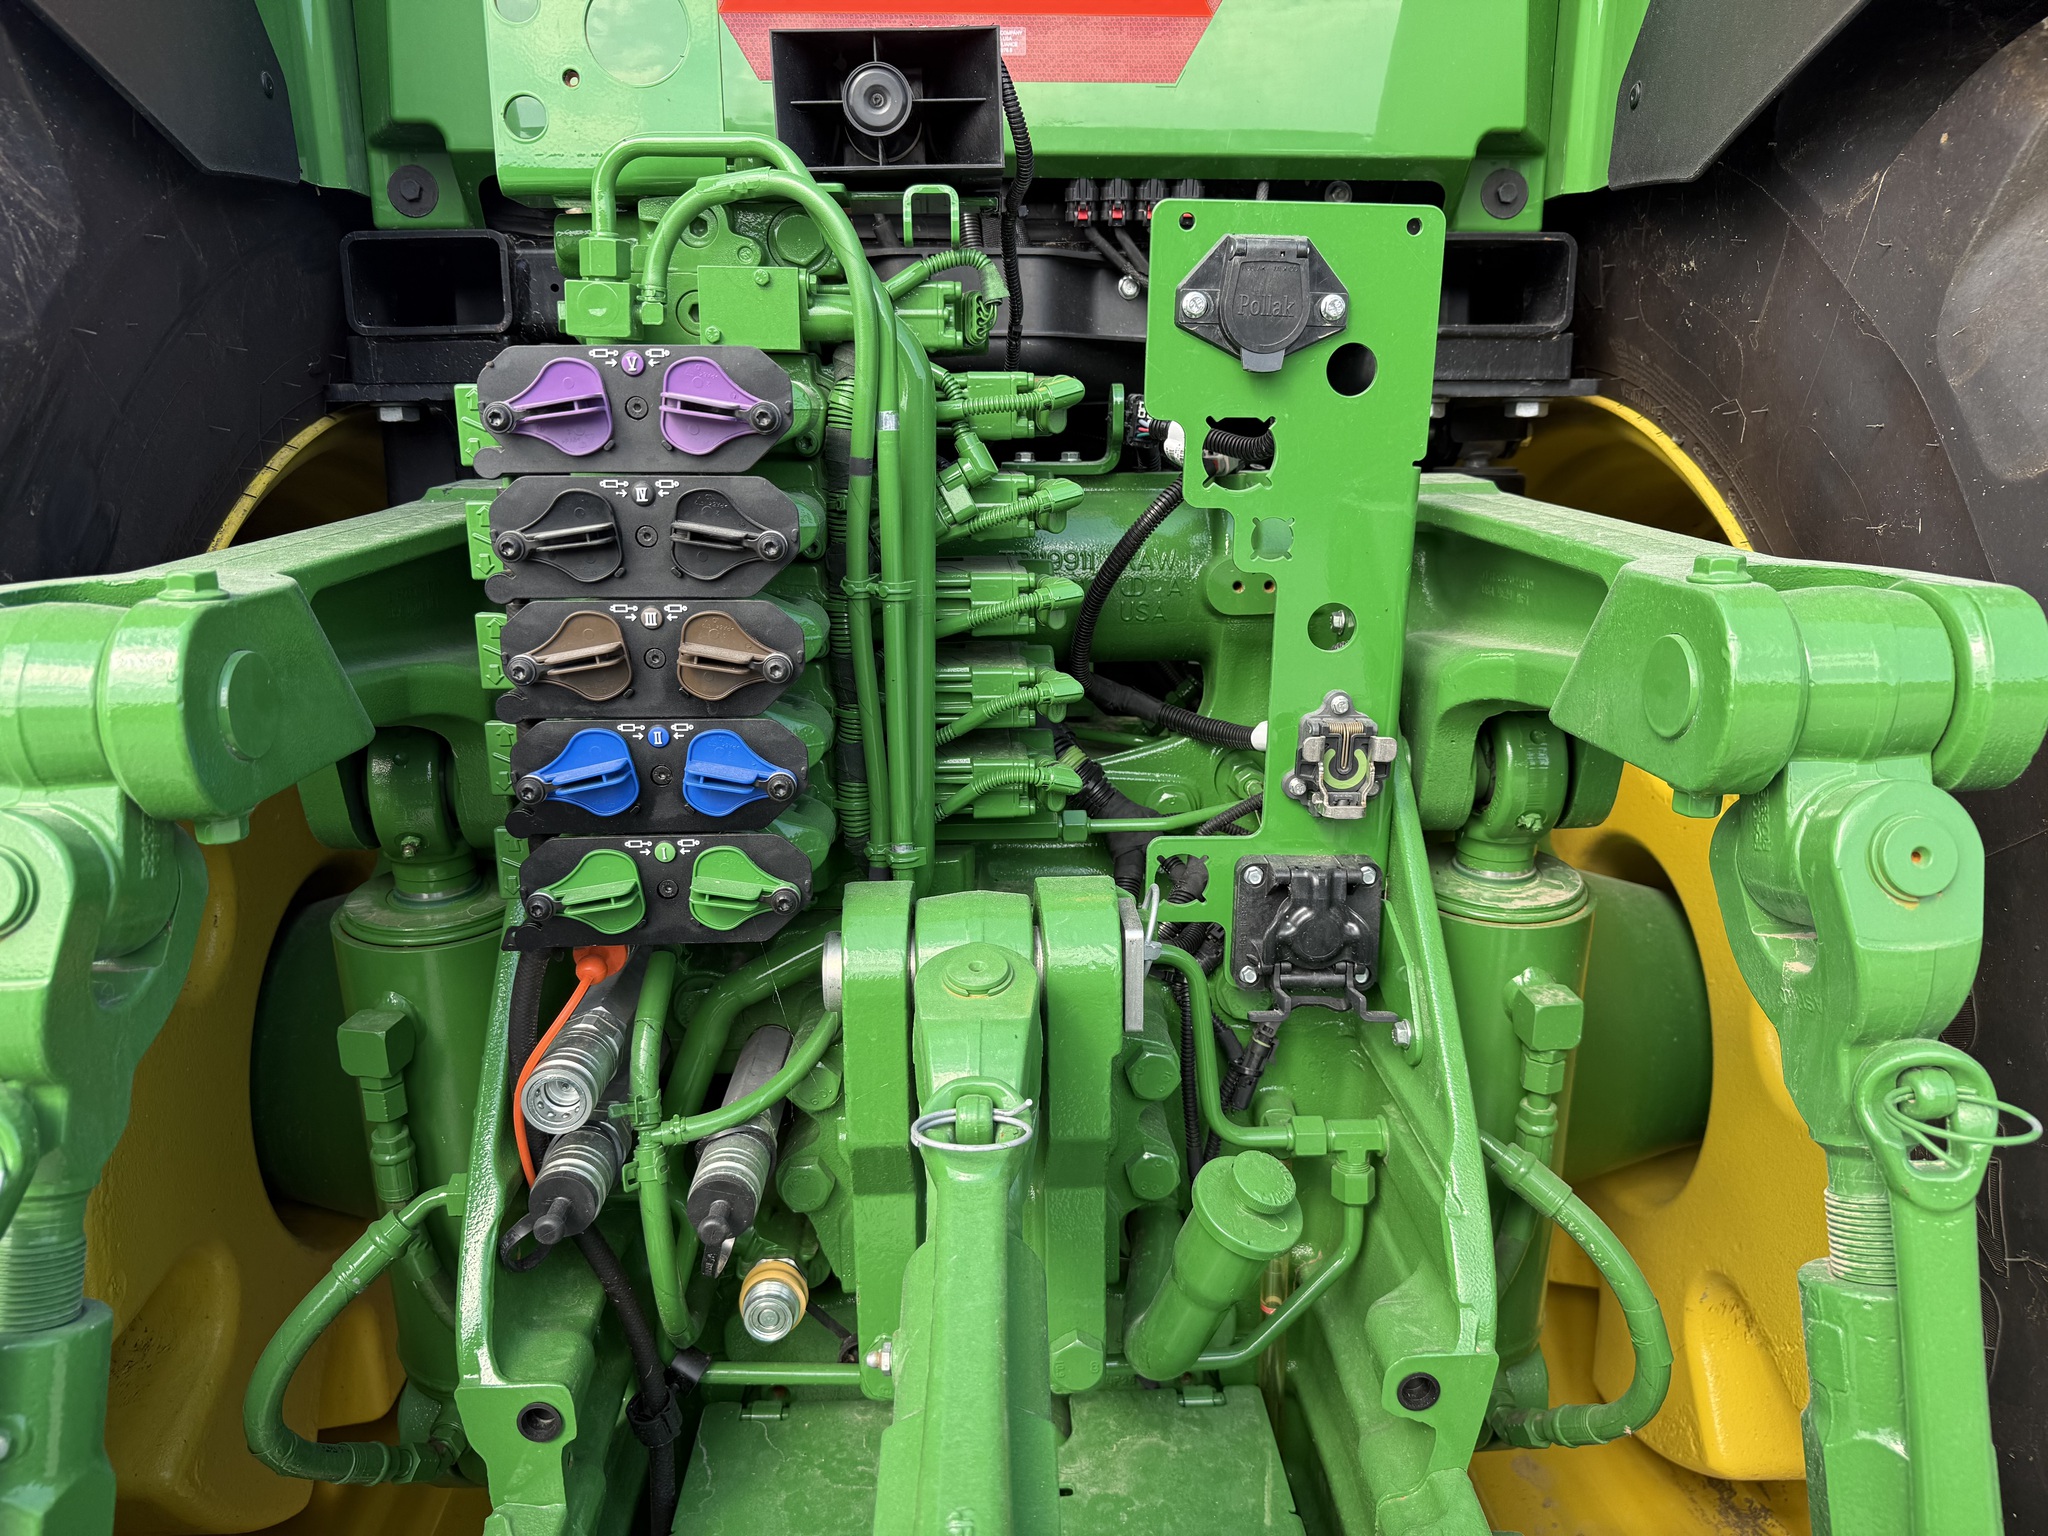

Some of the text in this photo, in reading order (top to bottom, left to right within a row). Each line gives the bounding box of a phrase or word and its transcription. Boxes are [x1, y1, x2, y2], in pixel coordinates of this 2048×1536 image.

[1238, 293, 1296, 317] Pollak
[626, 356, 637, 372] V
[635, 487, 648, 503] IV
[644, 611, 657, 625] III
[1120, 601, 1167, 622] USA
[653, 731, 663, 745] II
[661, 848, 667, 860] I
